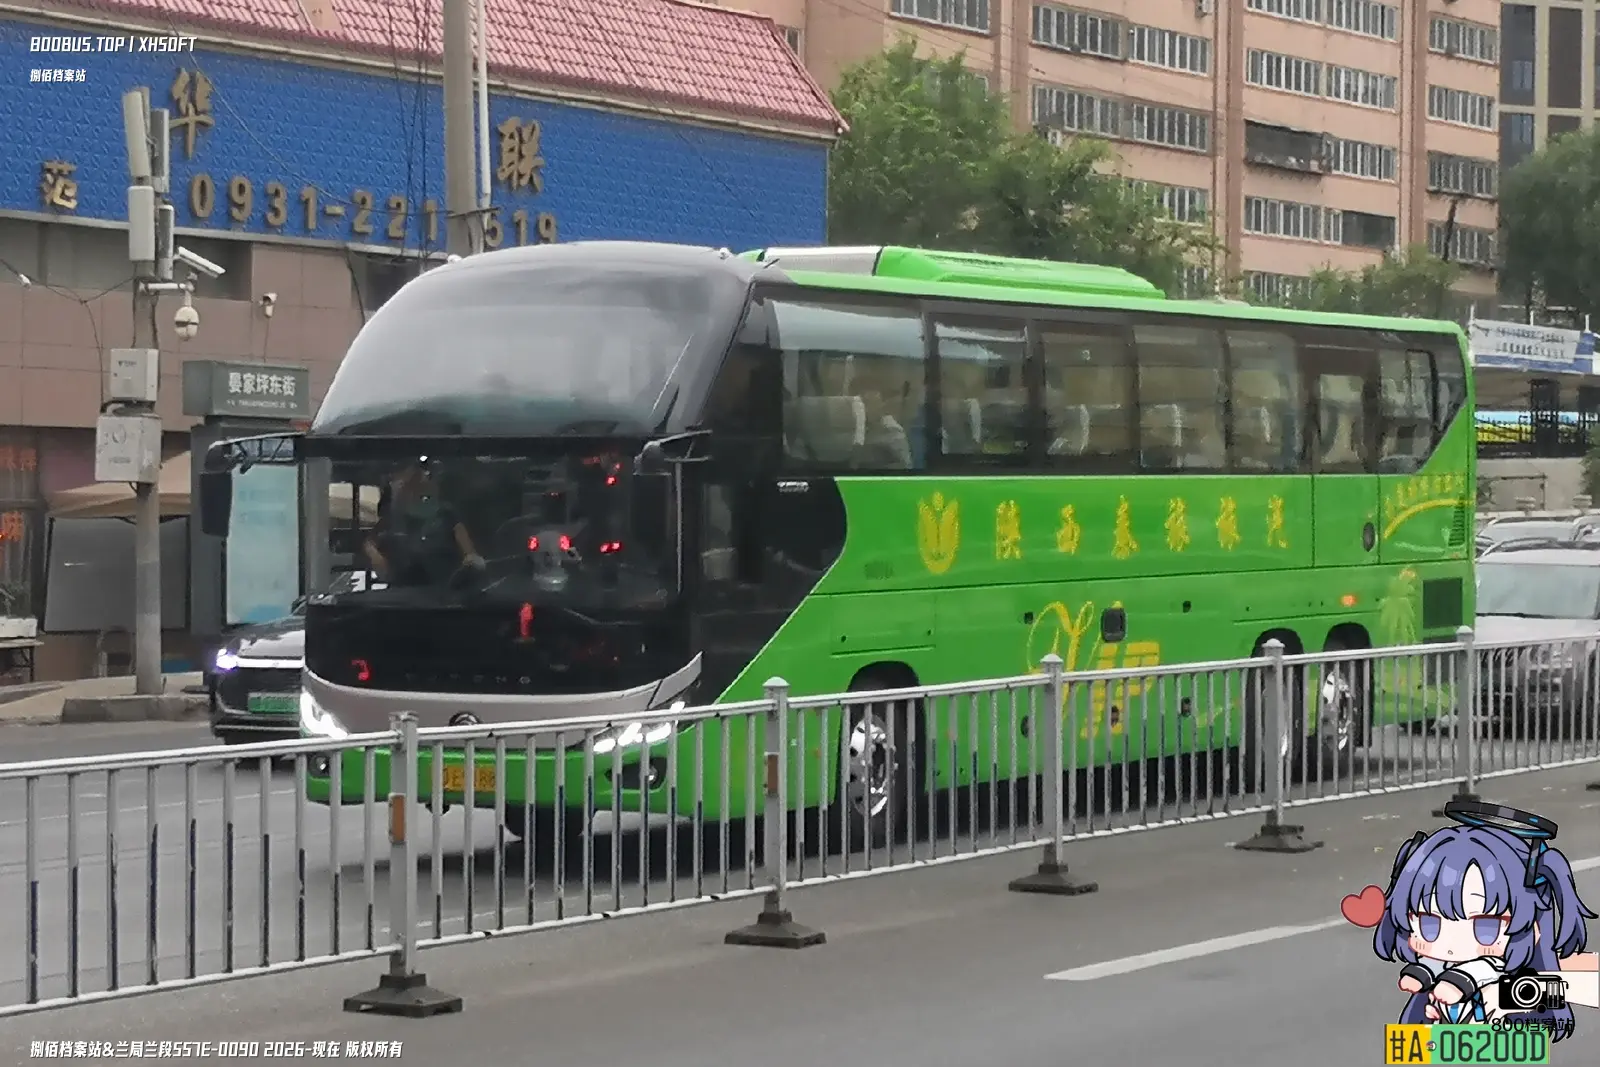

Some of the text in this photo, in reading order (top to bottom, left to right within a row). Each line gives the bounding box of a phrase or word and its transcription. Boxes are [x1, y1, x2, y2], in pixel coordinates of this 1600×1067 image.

[228, 372, 296, 397] 晏家坪东街
